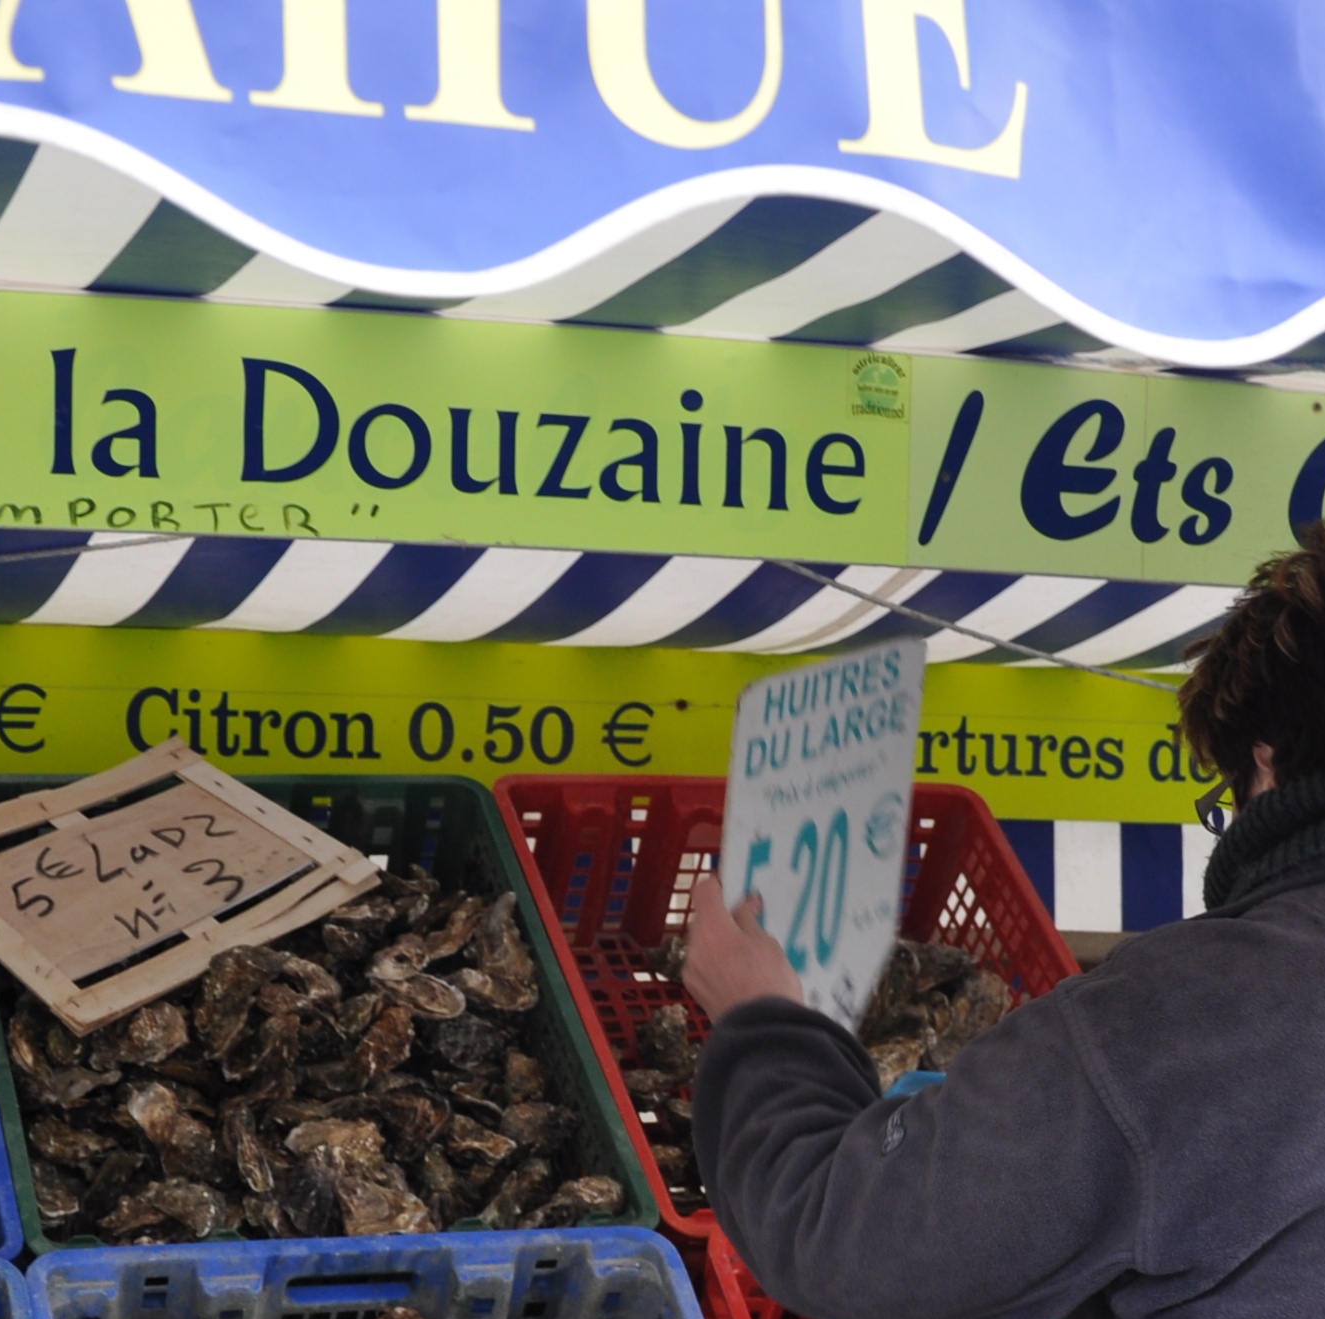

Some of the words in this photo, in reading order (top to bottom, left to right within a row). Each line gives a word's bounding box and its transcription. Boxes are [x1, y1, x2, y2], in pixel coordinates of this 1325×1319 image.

[50, 348, 160, 478] la
[240, 357, 867, 515] Douzaine
[918, 389, 984, 547] /
[1020, 398, 1234, 546] Ets
[762, 648, 903, 727] HUITRES
[126, 687, 381, 760] Citron
[408, 701, 575, 765] 0.50
[602, 702, 658, 767] €
[916, 716, 1125, 780] rtures
[745, 728, 791, 778] DU
[800, 691, 911, 760] LARGE
[183, 857, 245, 903] 3
